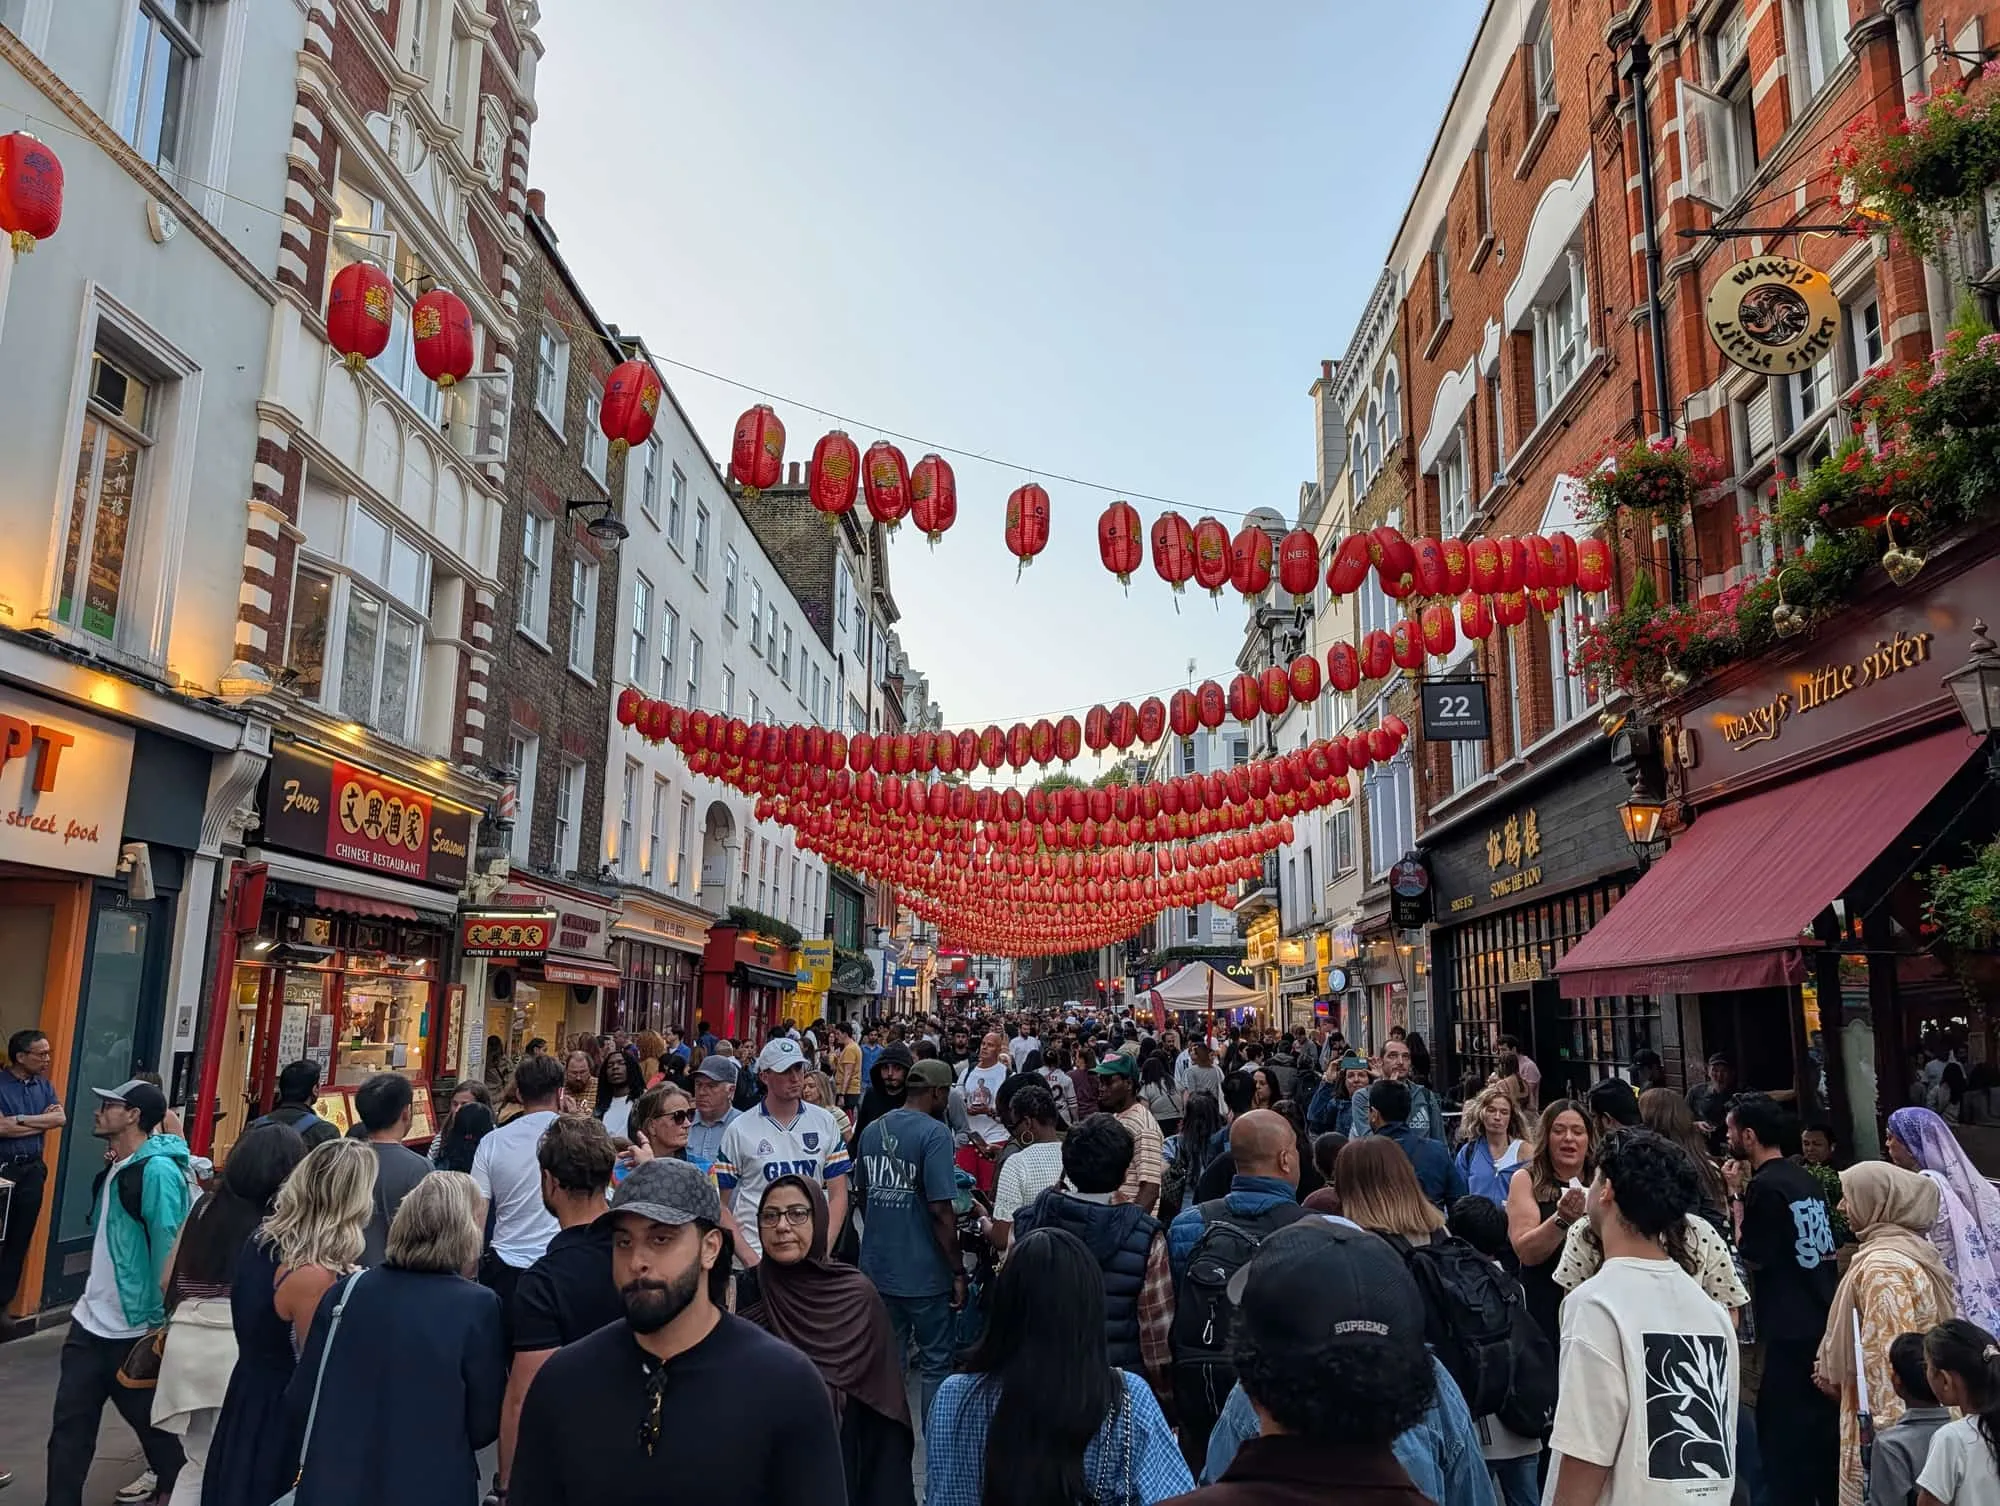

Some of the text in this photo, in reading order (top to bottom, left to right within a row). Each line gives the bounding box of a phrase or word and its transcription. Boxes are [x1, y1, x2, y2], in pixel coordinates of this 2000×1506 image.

[1439, 696, 1471, 718] 22
[283, 780, 320, 814] Four
[6, 808, 99, 845] street food
[341, 785, 422, 848] 文興酒家
[431, 827, 467, 858] Seasons
[335, 843, 421, 876] CHINESE RESTAURANT
[265, 882, 278, 896] 23
[1490, 878, 1513, 900] SONG
[1511, 873, 1525, 893] HE
[469, 926, 542, 946] 文興酒家
[763, 1159, 818, 1184] GAIN
[1334, 1320, 1390, 1336] SUPREME
